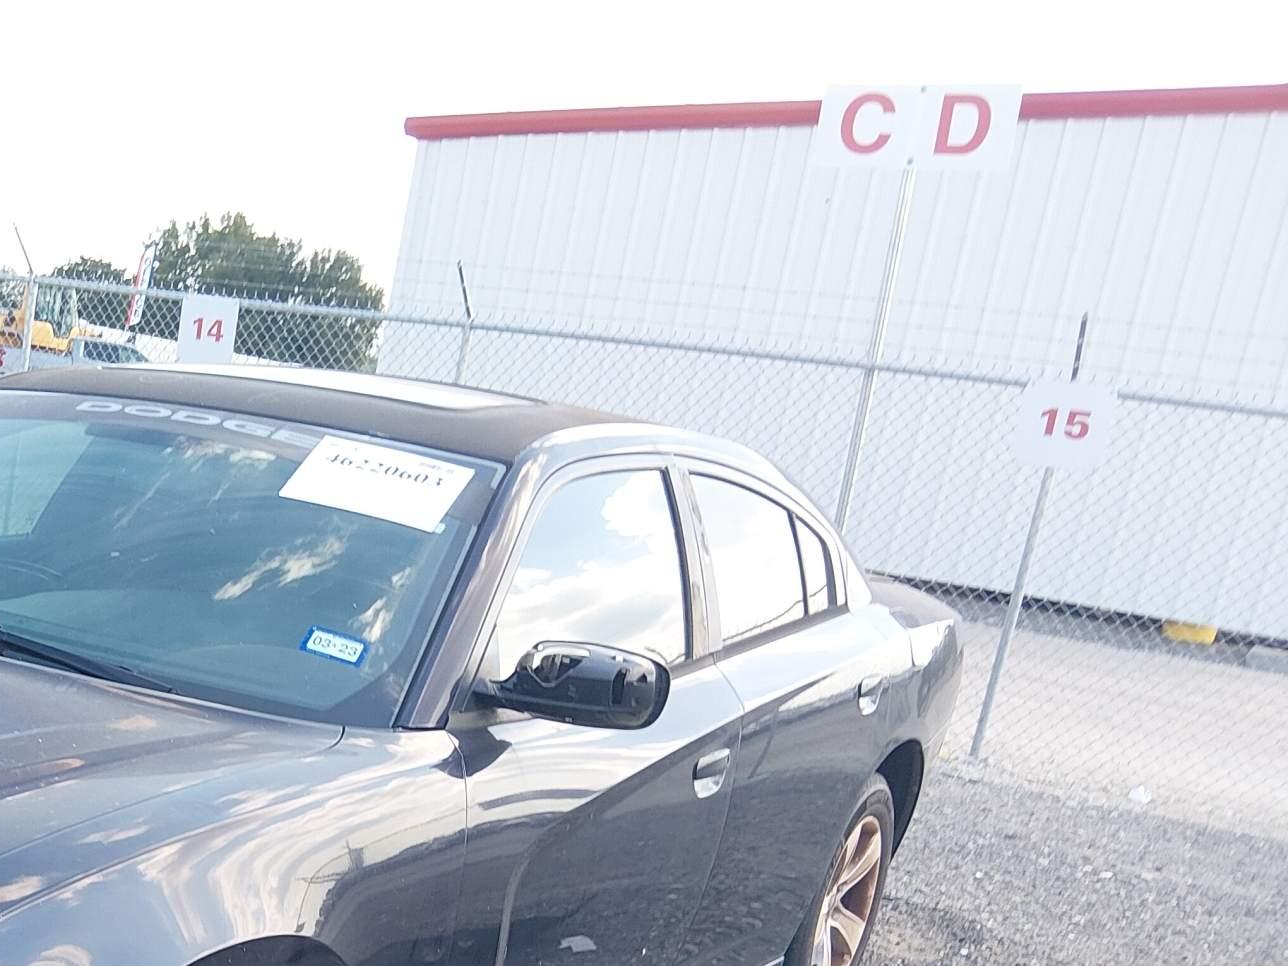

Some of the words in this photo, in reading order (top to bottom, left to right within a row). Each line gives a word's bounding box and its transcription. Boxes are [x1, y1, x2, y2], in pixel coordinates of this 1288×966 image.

[840, 92, 896, 155] C
[933, 94, 992, 155] D
[193, 318, 224, 342] 14
[1040, 407, 1092, 439] 15
